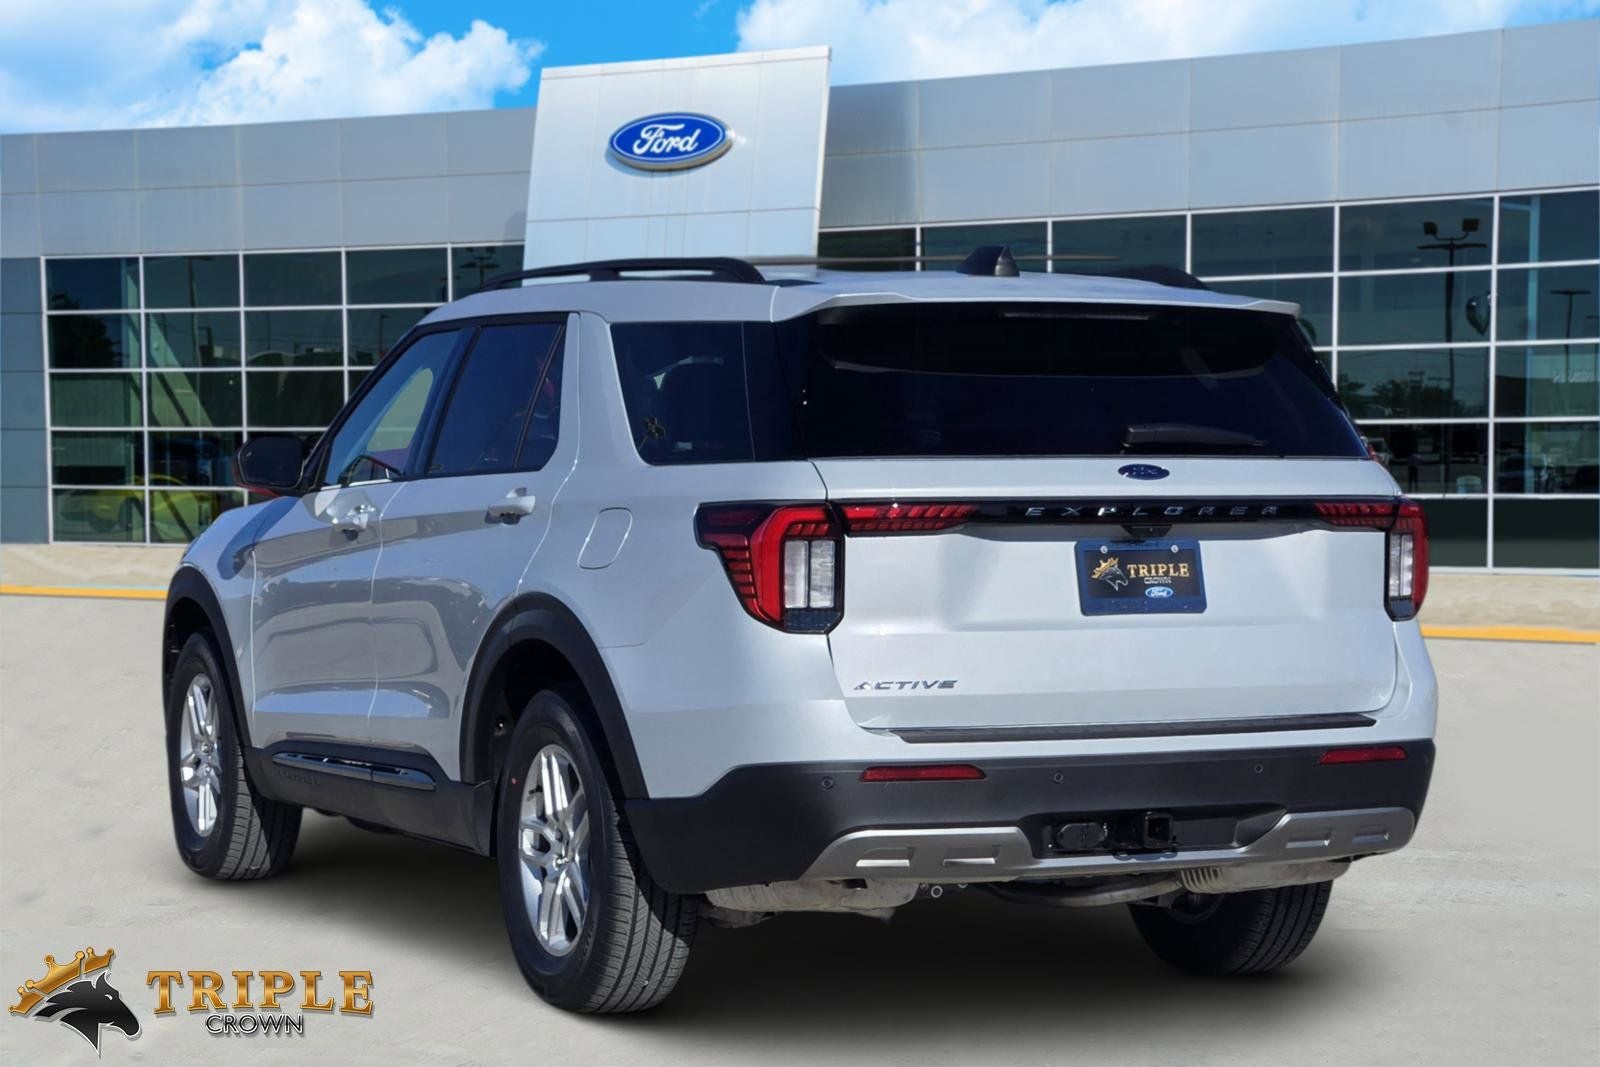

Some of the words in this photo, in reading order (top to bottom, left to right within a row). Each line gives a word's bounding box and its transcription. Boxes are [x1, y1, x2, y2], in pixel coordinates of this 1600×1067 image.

[632, 123, 702, 155] Ford
[1025, 506, 1280, 517] EXPLORER
[1127, 563, 1189, 578] TRIPLE
[853, 679, 958, 691] ACTIVE
